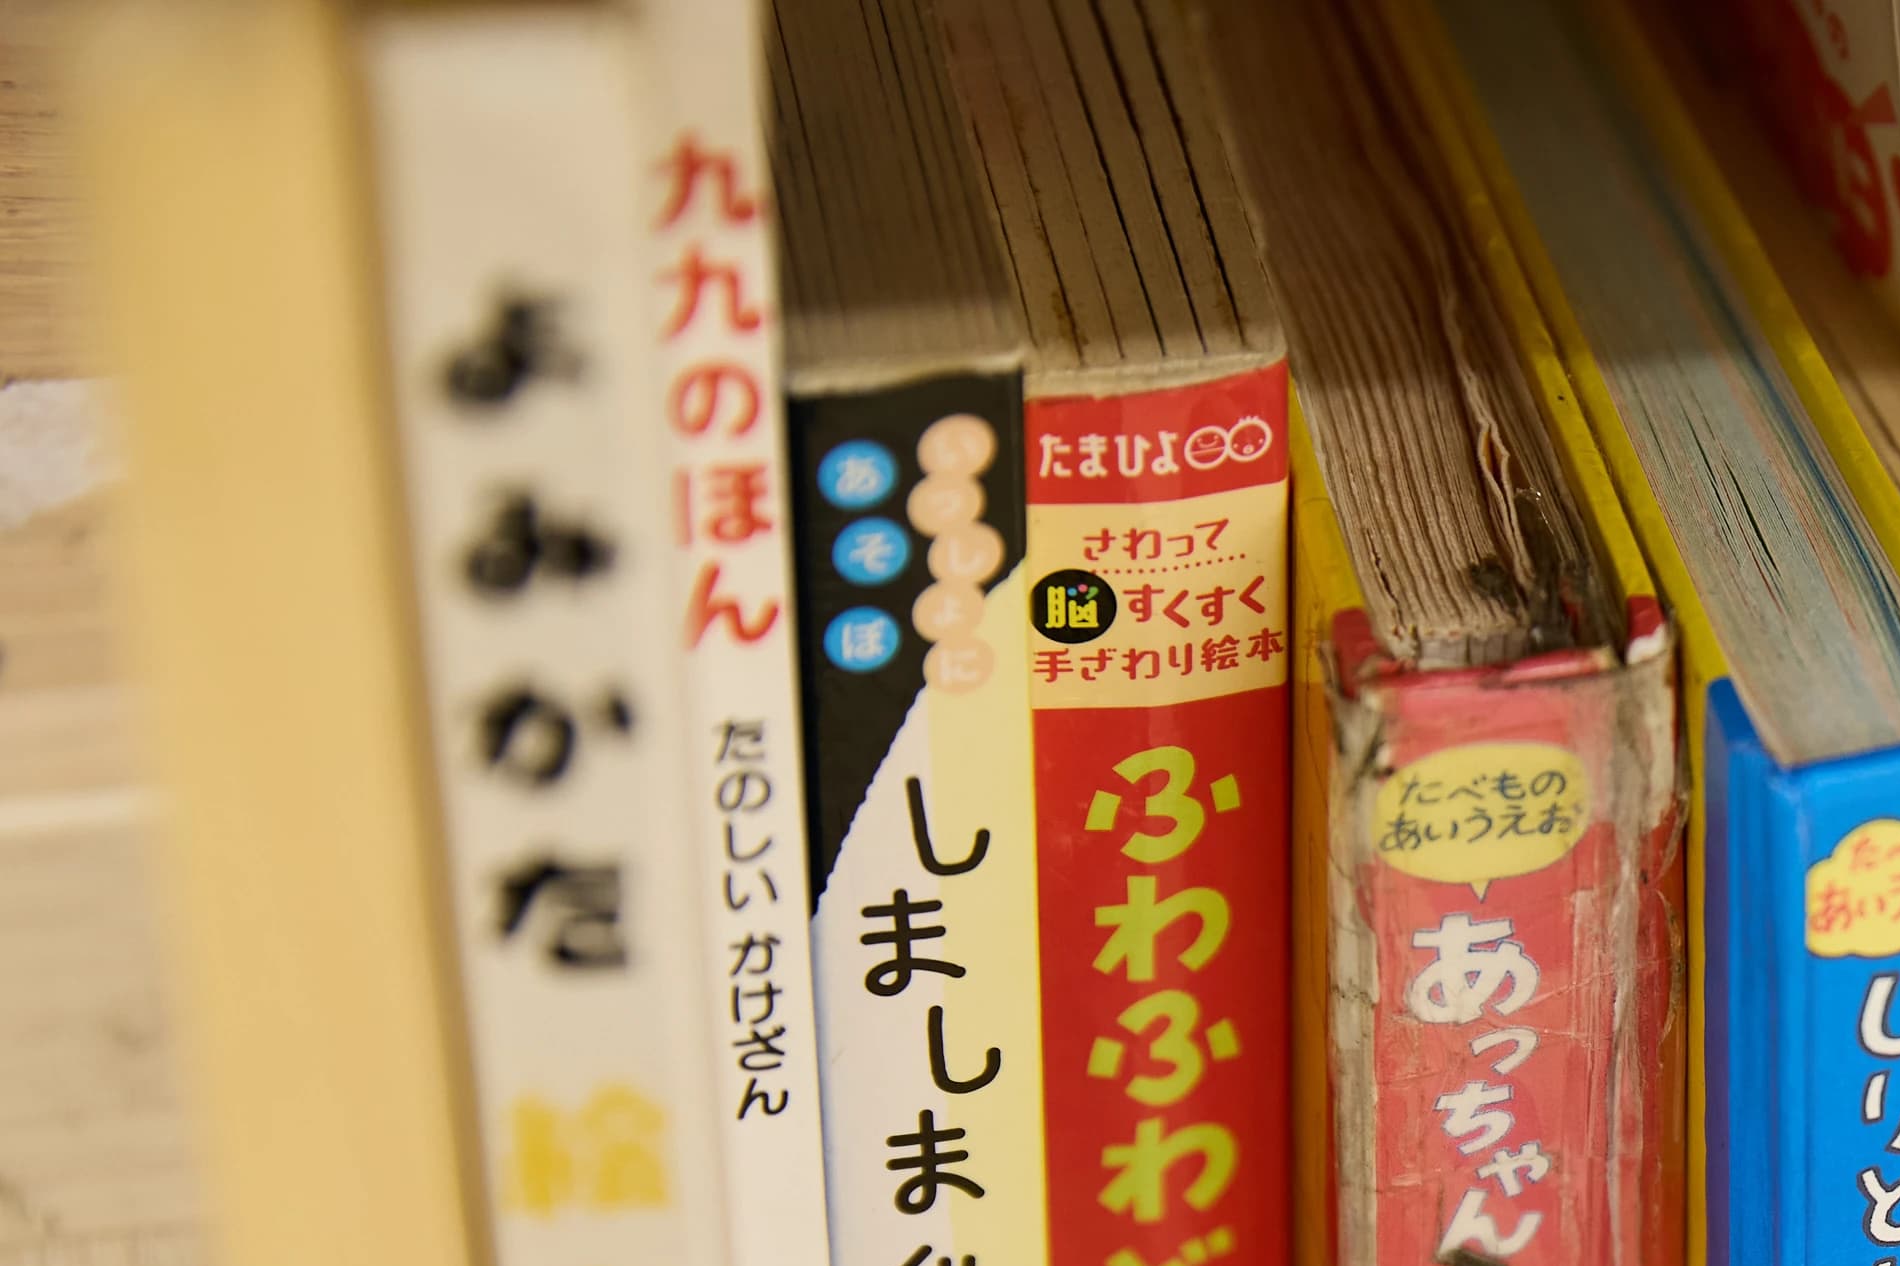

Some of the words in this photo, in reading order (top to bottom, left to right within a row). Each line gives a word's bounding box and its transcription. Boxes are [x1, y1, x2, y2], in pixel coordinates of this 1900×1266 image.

[653, 133, 780, 652] 九九のほん
[1039, 430, 1181, 478] たまひよ
[836, 453, 893, 661] あそぼ
[1082, 518, 1230, 562] さわって
[1045, 585, 1100, 629] 脳
[1122, 575, 1266, 629] すくすく
[1032, 627, 1285, 684] 手ざわり絵本
[713, 717, 778, 912] たのしい
[1400, 770, 1567, 806] たべもの
[1379, 802, 1584, 852] あいうえお
[728, 934, 790, 1121] かけざん
